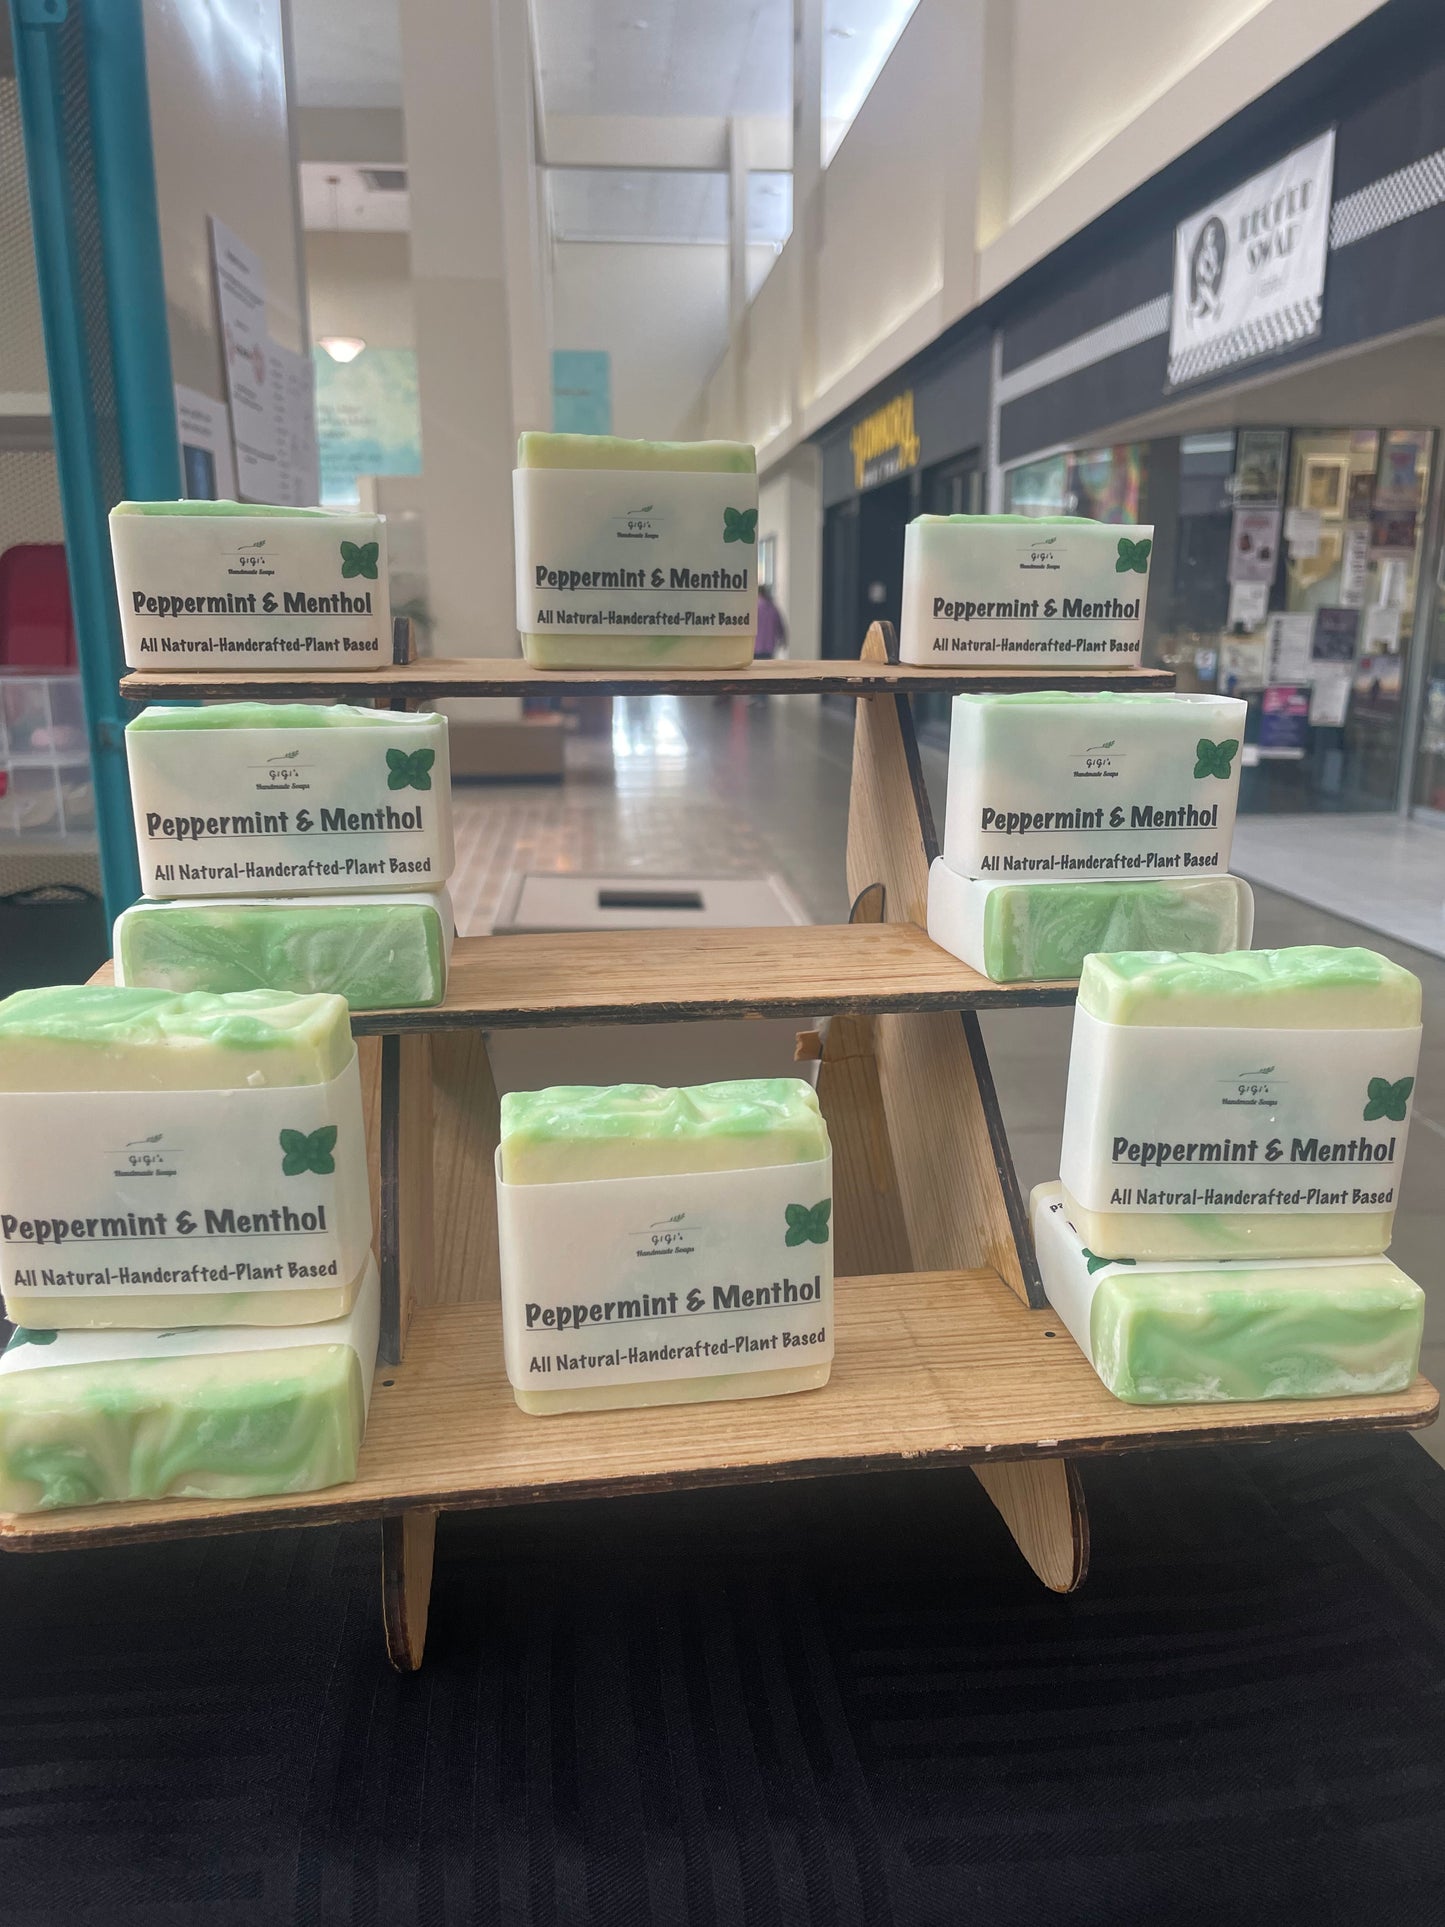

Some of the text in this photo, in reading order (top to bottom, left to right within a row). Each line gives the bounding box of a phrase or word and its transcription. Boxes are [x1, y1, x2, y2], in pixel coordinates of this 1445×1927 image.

[536, 566, 748, 591] Peppermint & Menthol
[133, 591, 371, 618] Peppermint & Menthol
[933, 597, 1140, 621] Peppermint & Menthol
[537, 610, 749, 626] All Natural-Handcrafted-Plant Based
[140, 638, 379, 652] All Natural-Handcrafted-Plant Based
[932, 638, 1140, 652] All Natural-Handcrafted-Plant Based
[1102, 770, 1119, 778] Soaps
[146, 807, 423, 840] Peppermint & Menthol
[981, 805, 1218, 835] Peppermint & Menthol
[155, 857, 431, 882] All Natural-Handcrafted-Plant Based
[981, 852, 1218, 870] All Natural-Handcrafted-Plant Based
[1112, 1137, 1395, 1167] Peppermint & Menthol
[1111, 1188, 1393, 1205] All Natural-Handcrafted-Plant Based
[1, 1205, 326, 1245] Peppermint & Menthol
[636, 1246, 695, 1258] Handmade Soaps
[14, 1260, 338, 1287] All Natural-Handcrafted-Plant Based
[526, 1276, 821, 1331] Peppermint & Menthol
[530, 1328, 825, 1373] All Natural-Handcrafted-Plant Based
